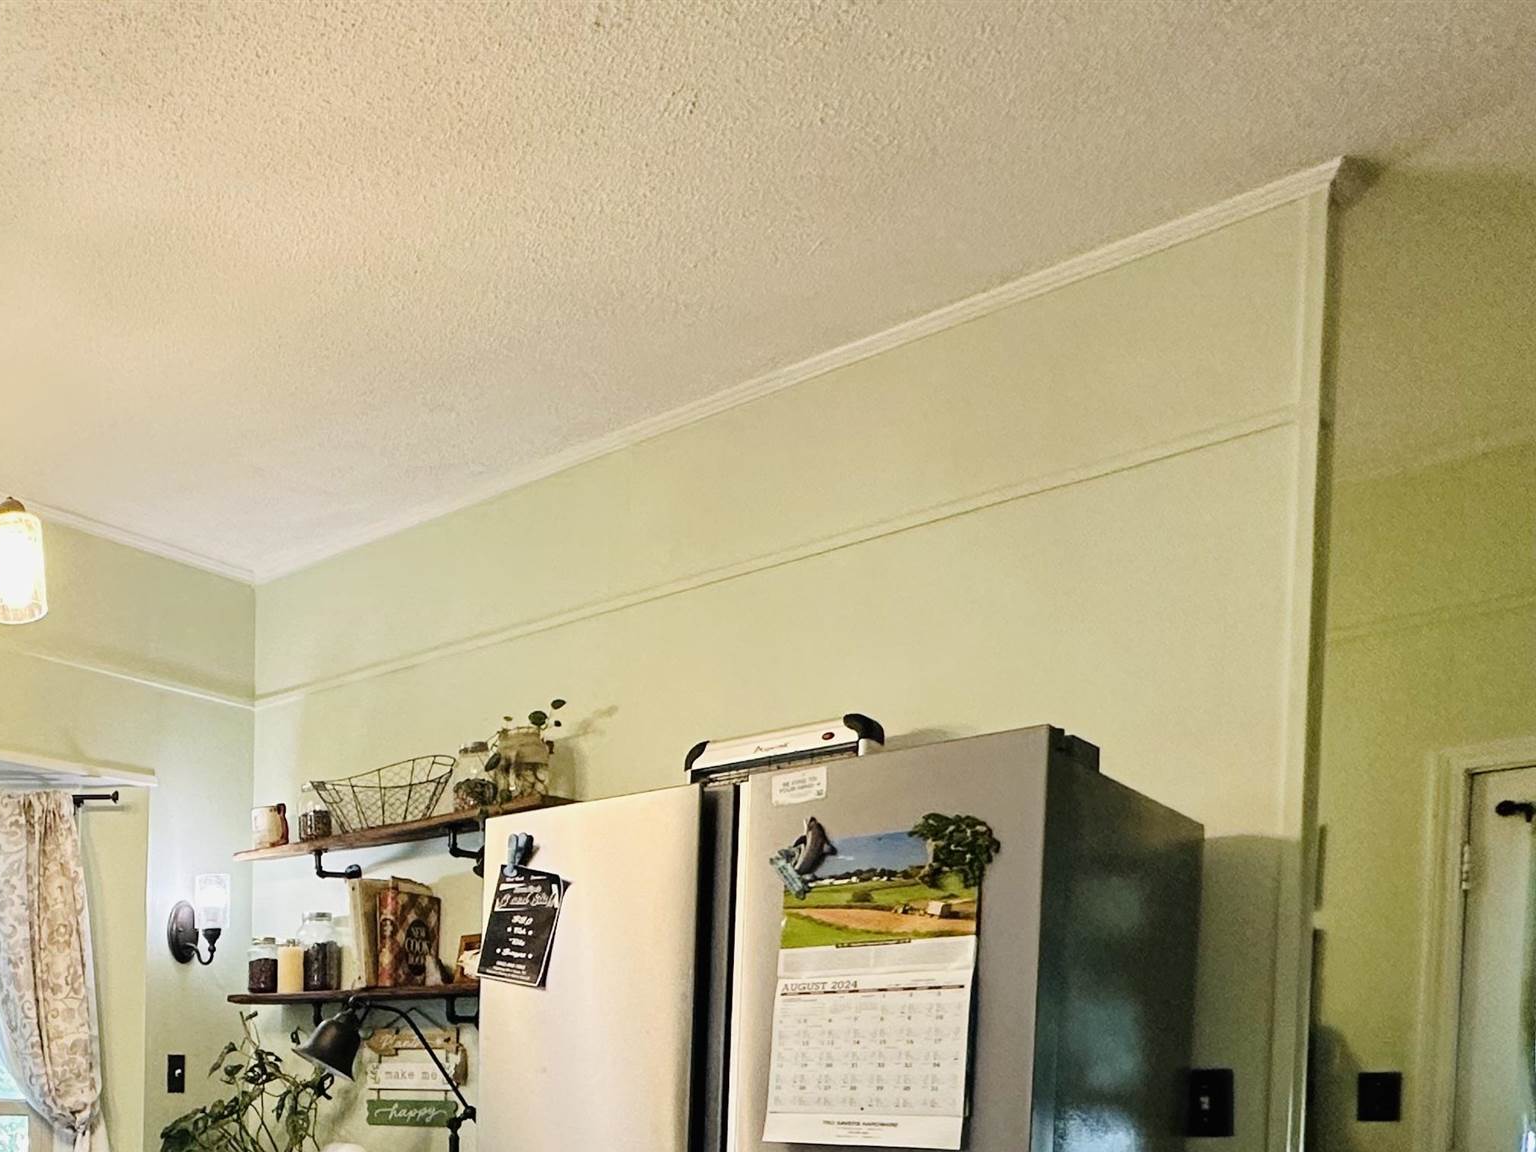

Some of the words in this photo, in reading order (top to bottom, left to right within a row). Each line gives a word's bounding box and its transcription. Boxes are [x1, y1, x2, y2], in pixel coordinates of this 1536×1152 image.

[782, 982, 827, 992] AUGUST
[831, 980, 858, 990] 2024
[385, 1069, 415, 1080] make
[421, 1071, 438, 1081] me
[374, 1102, 448, 1123] happy
